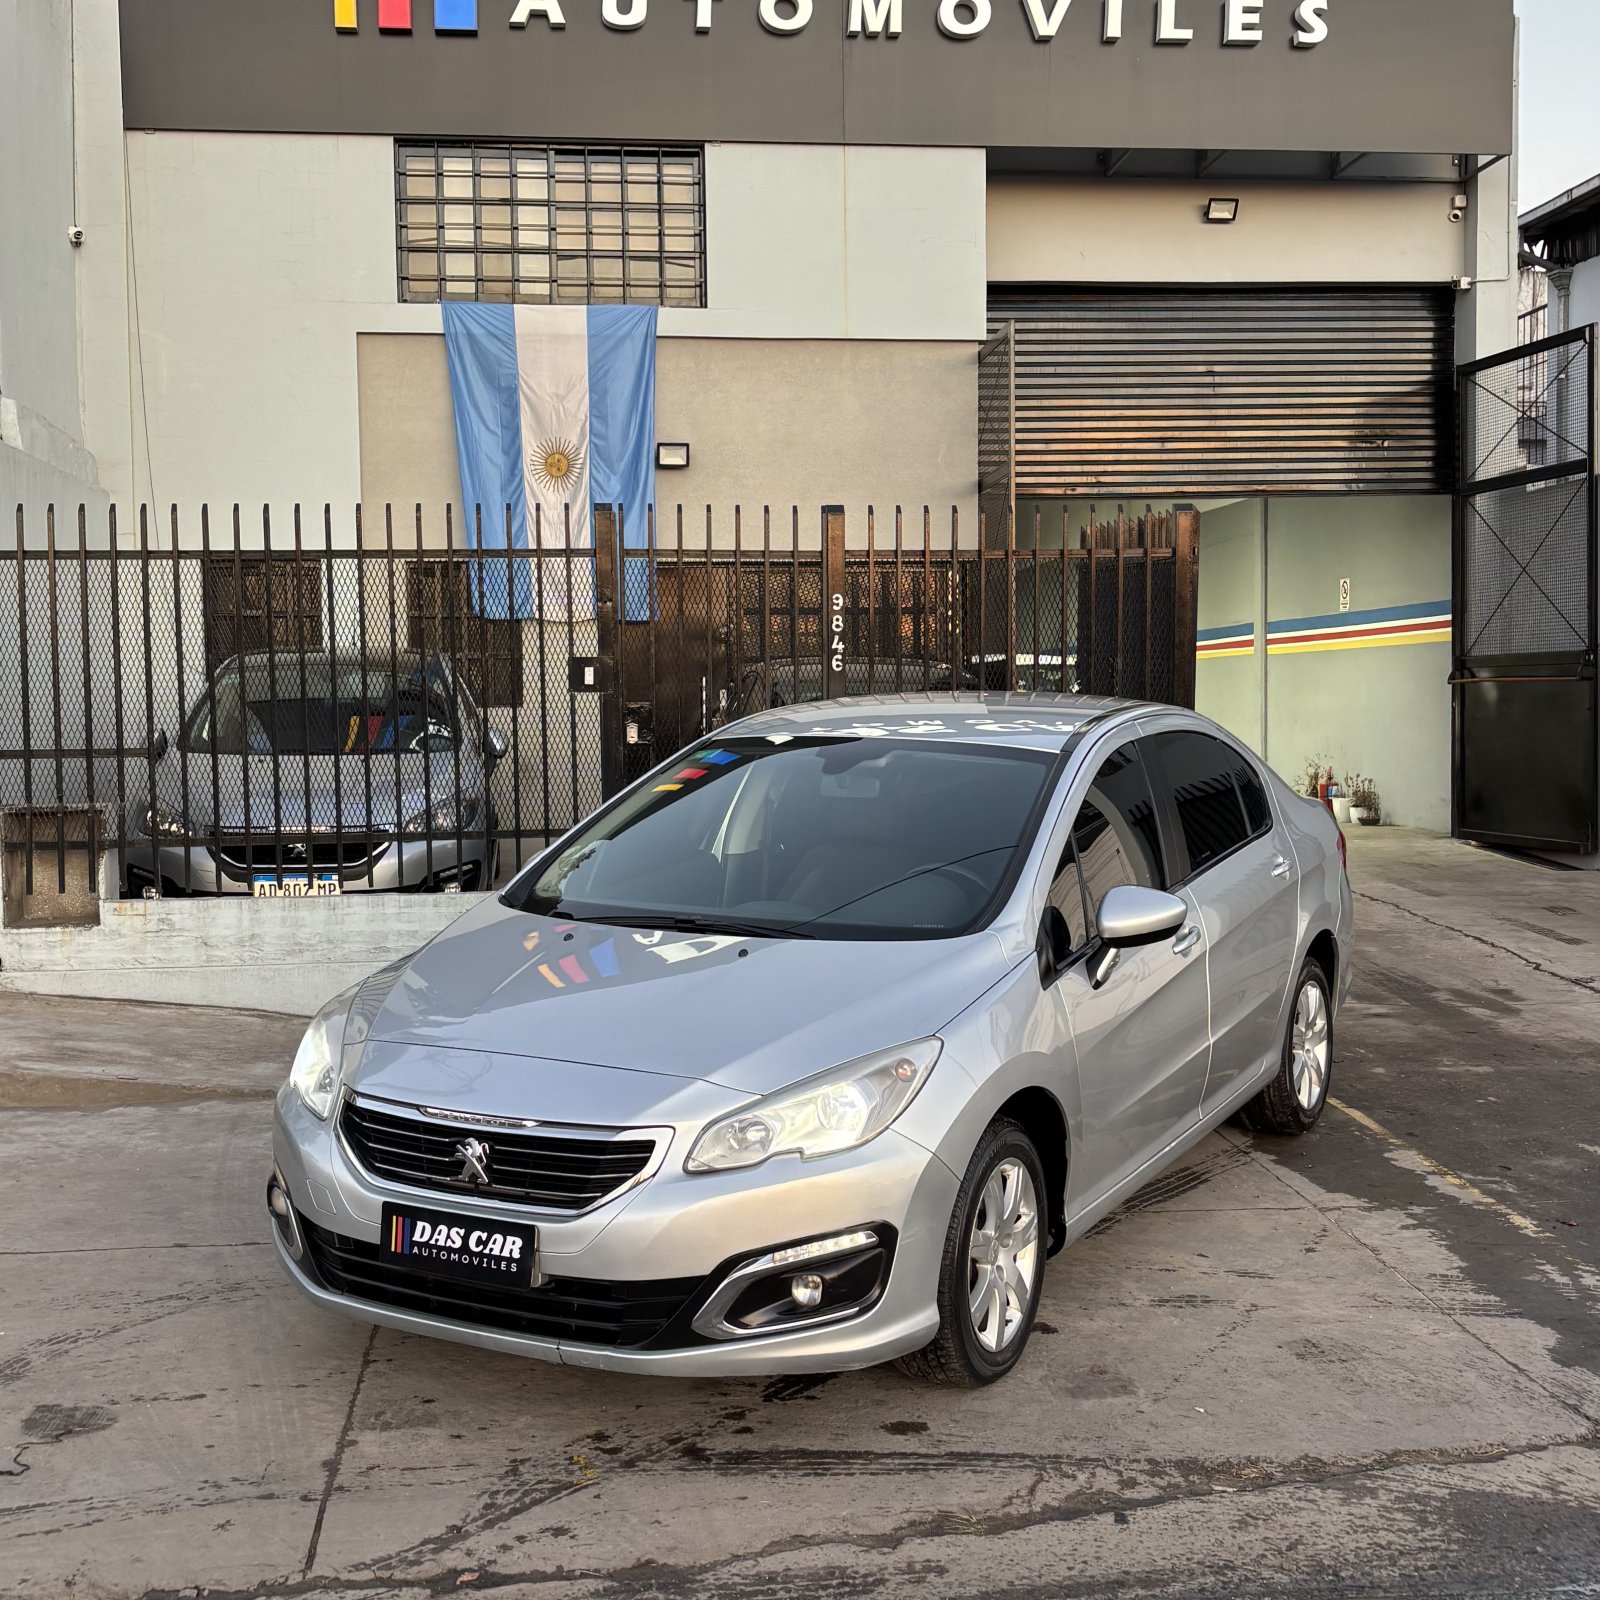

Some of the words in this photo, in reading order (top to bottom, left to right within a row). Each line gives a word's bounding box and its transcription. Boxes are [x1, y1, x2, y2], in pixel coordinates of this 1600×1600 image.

[831, 593, 845, 671] 9846
[317, 883, 336, 896] MP
[438, 1110, 515, 1127] PEUGEOT
[412, 1220, 465, 1249] DAS
[468, 1230, 523, 1258] CAR
[412, 1246, 518, 1272] AUTOMOVILES
